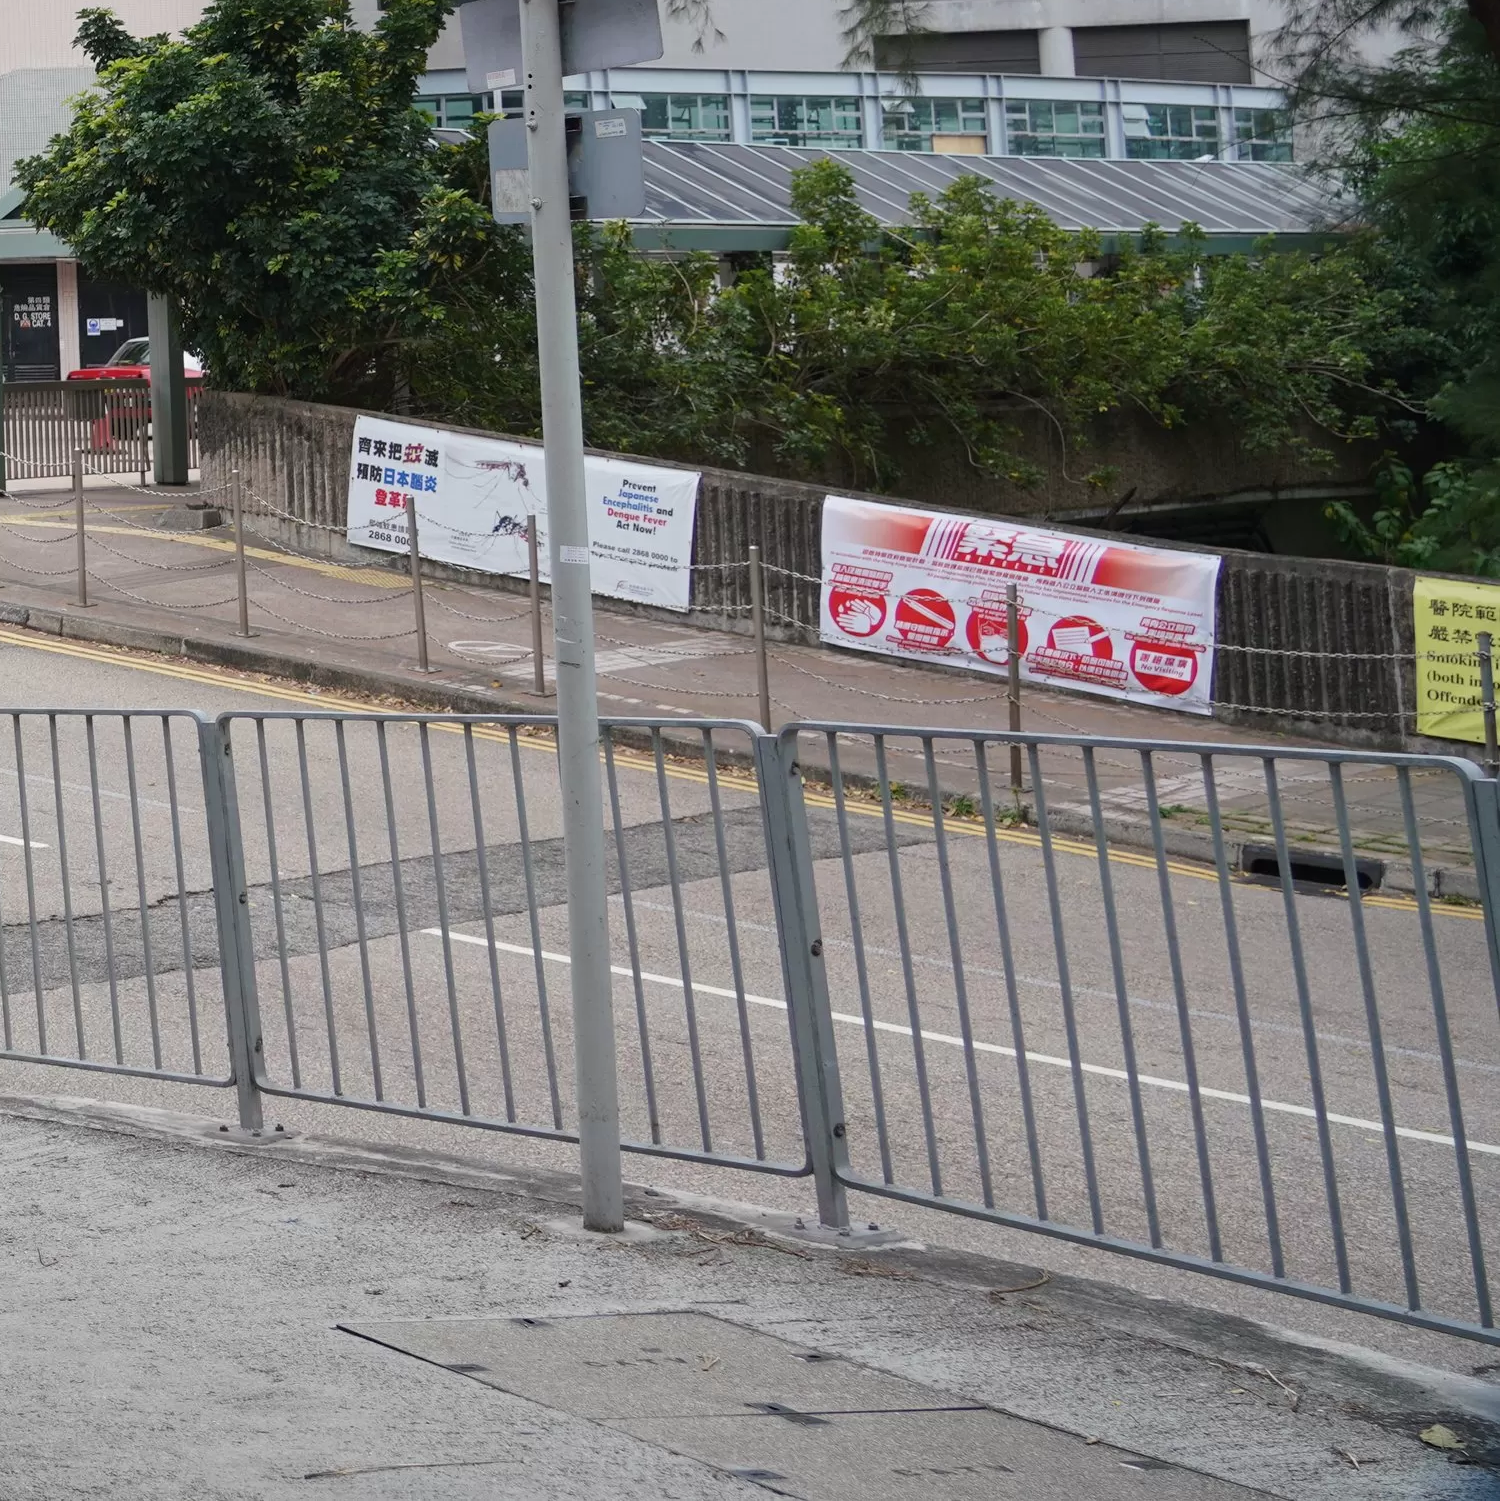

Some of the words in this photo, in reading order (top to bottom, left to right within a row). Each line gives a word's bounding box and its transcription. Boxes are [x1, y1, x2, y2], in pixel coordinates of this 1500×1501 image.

[30, 312, 51, 320] STORE
[46, 319, 51, 327] 4
[356, 462, 437, 493] 預防日本腦炎
[622, 479, 656, 493] Prevent
[618, 489, 659, 504] Japanese
[602, 496, 653, 513] Encephalitis
[656, 507, 674, 517] and
[607, 508, 640, 522] Dengue
[643, 514, 667, 527] Fever
[368, 530, 391, 542] 2868
[616, 520, 630, 531] Act
[633, 523, 656, 535] Now!
[592, 541, 616, 551] Please
[618, 546, 630, 554] call
[632, 548, 650, 558] 2868
[651, 552, 668, 562] 0000
[670, 556, 678, 564] to
[957, 523, 1067, 570] 緊急
[1428, 599, 1500, 622] 醫院範
[1428, 625, 1500, 648] 嚴禁
[1427, 650, 1481, 667] Smokin
[1141, 663, 1152, 671] No
[1154, 664, 1184, 677] Visiting
[1427, 670, 1464, 685] (both
[1427, 689, 1483, 707] Offende
